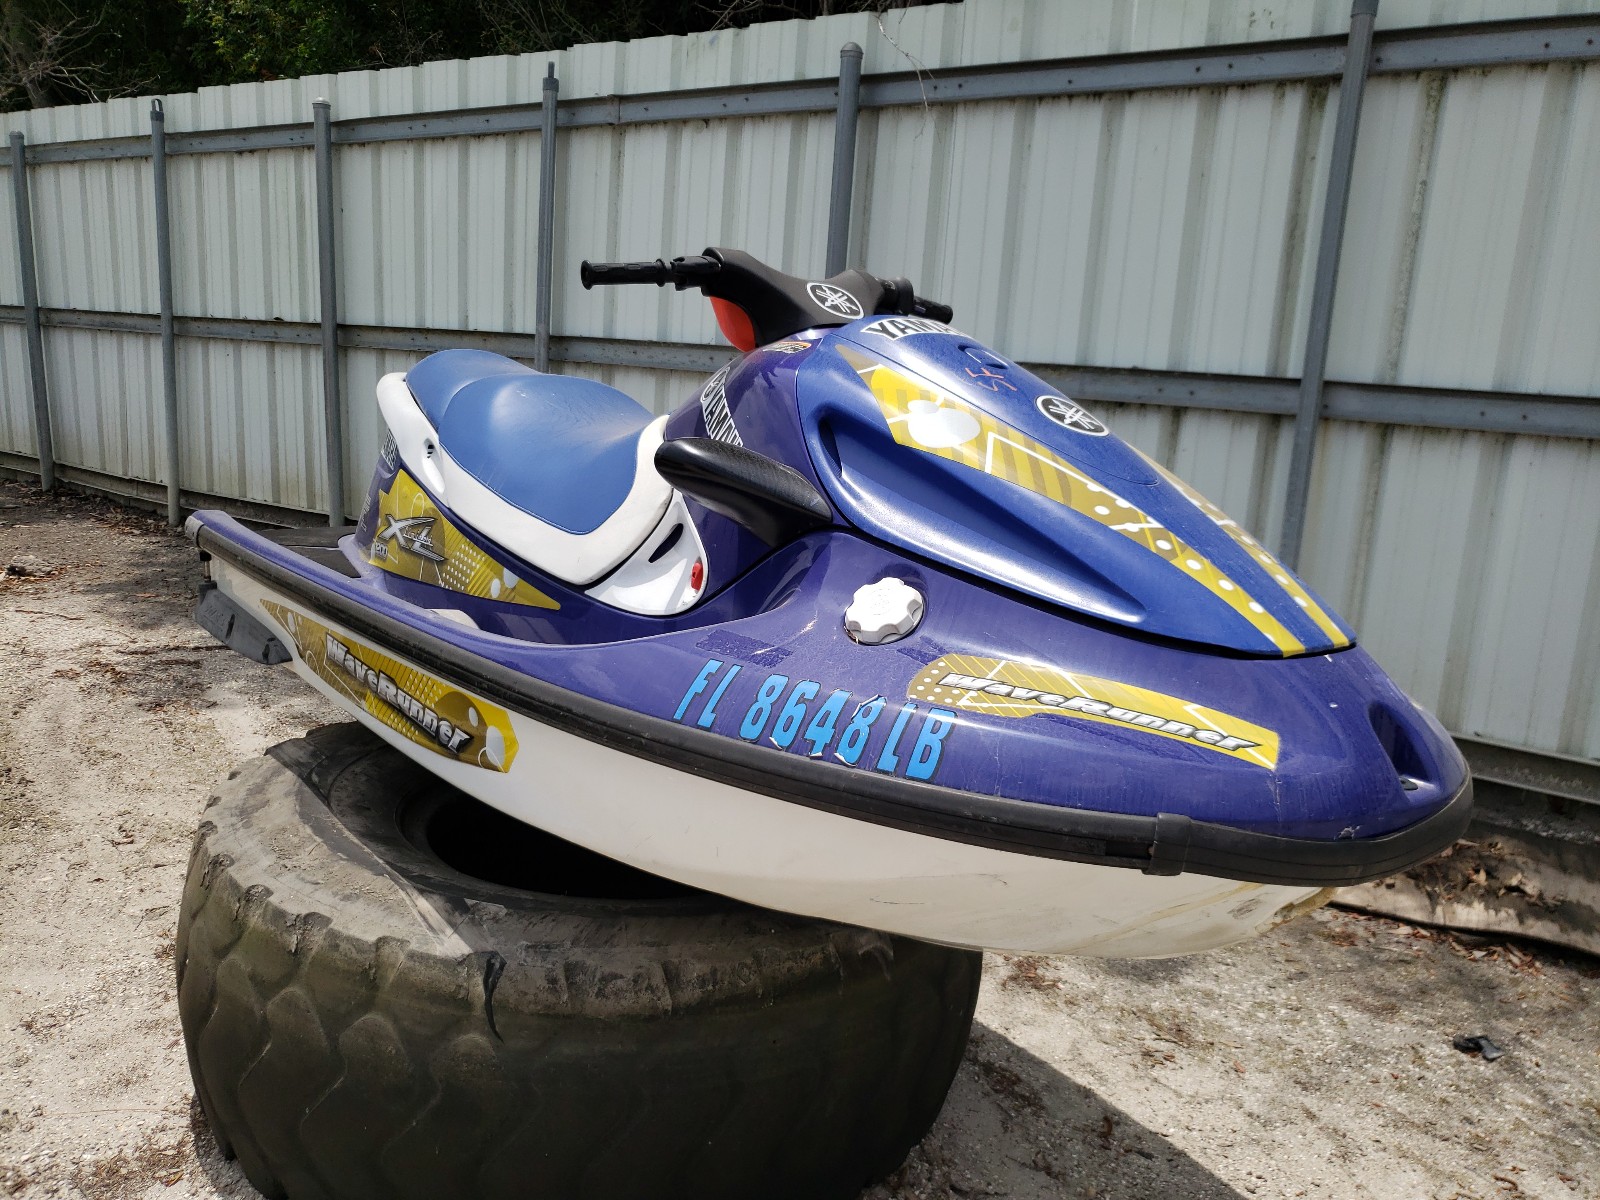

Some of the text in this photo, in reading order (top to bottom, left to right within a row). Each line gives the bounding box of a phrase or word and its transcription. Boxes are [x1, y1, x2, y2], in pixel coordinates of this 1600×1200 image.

[326, 632, 474, 754] WaveRunner
[673, 658, 959, 782] FL 8648 LB
[936, 672, 1262, 752] WaveRunner
